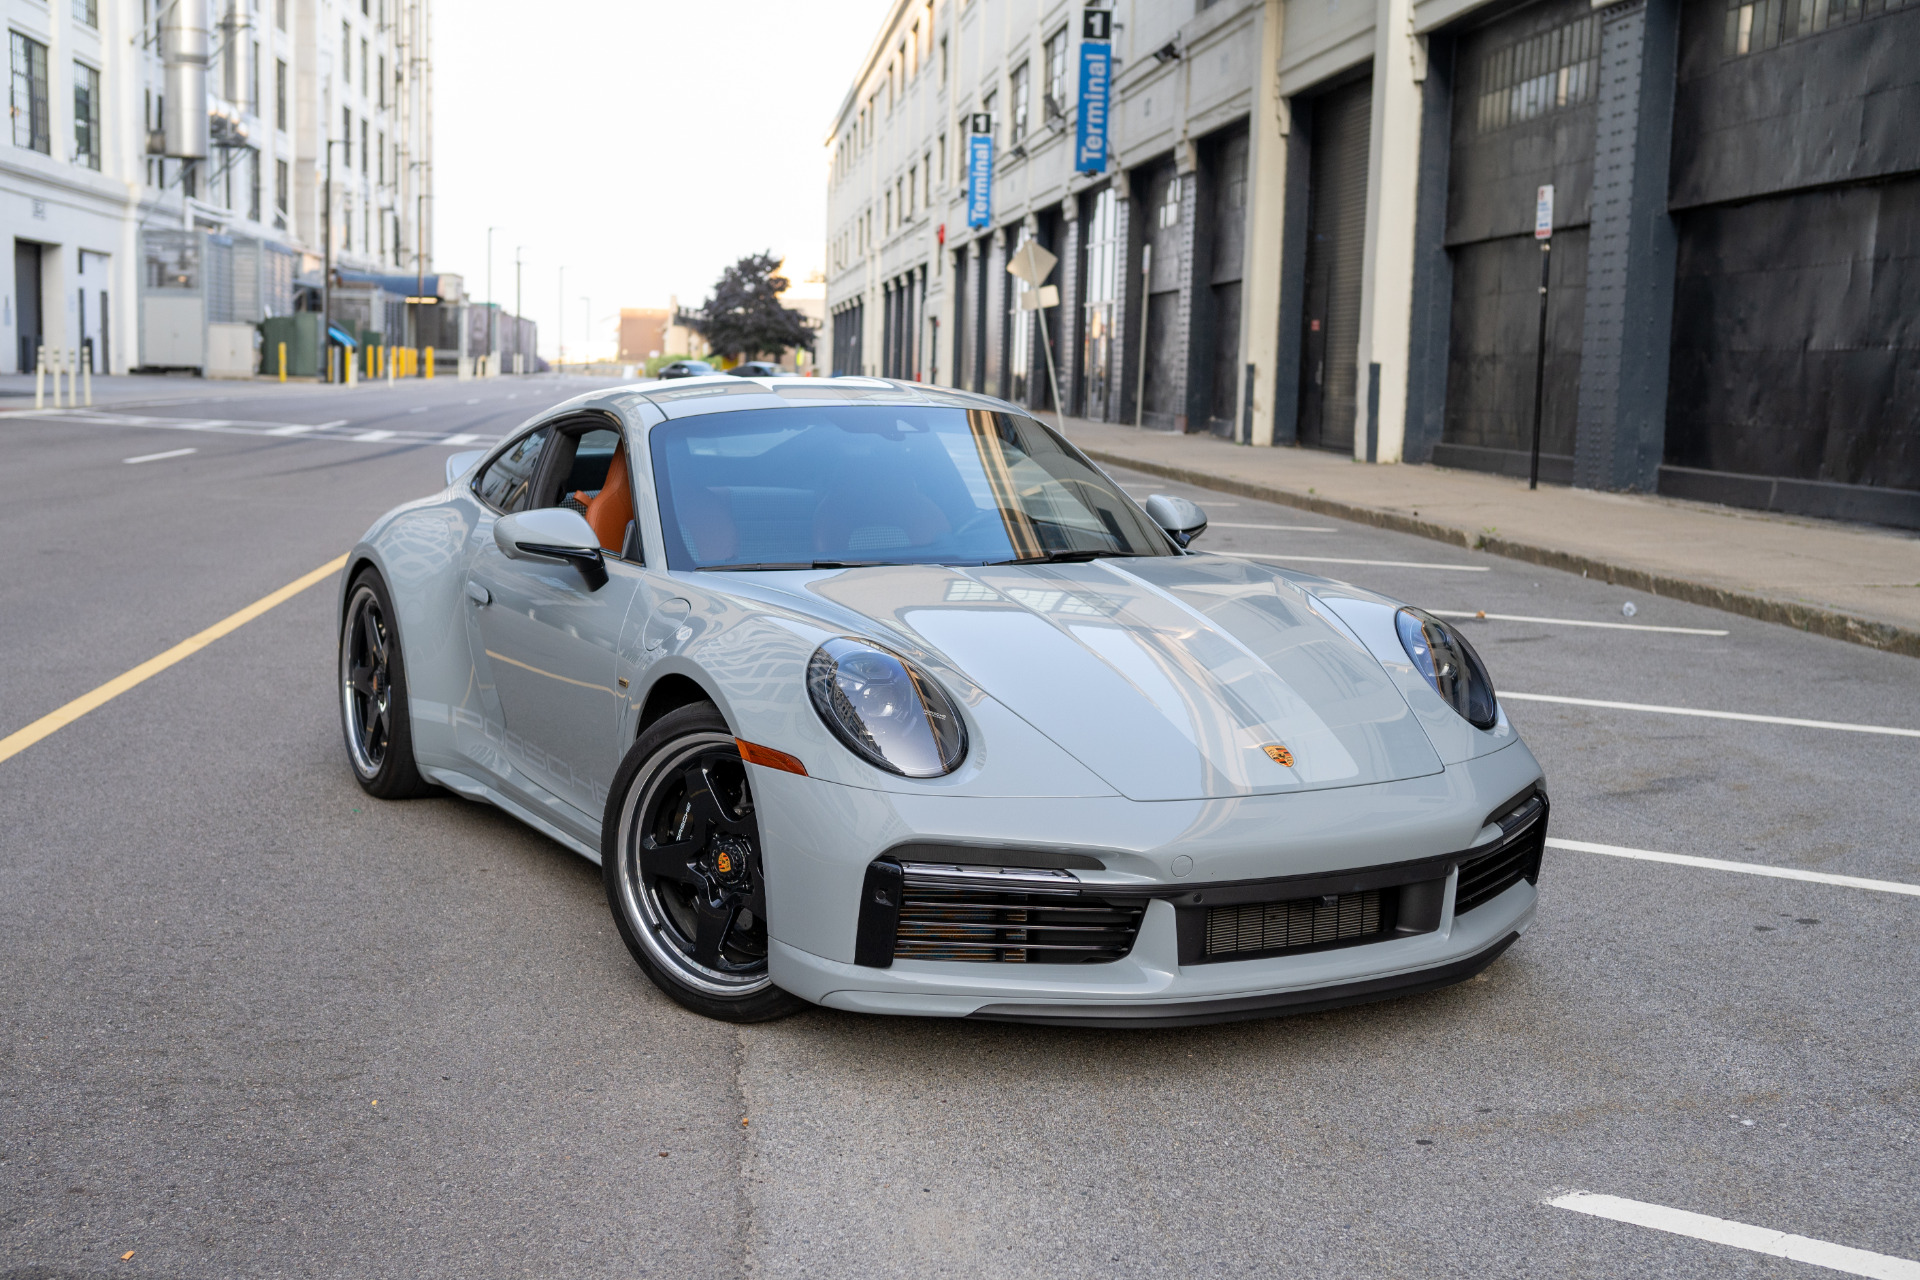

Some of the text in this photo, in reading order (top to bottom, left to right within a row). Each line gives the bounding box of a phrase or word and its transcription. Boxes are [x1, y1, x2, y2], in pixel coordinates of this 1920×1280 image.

[1088, 12, 1104, 37] 1
[975, 115, 987, 132] 1
[1081, 54, 1106, 164] Terminal
[971, 143, 989, 222] Terminal
